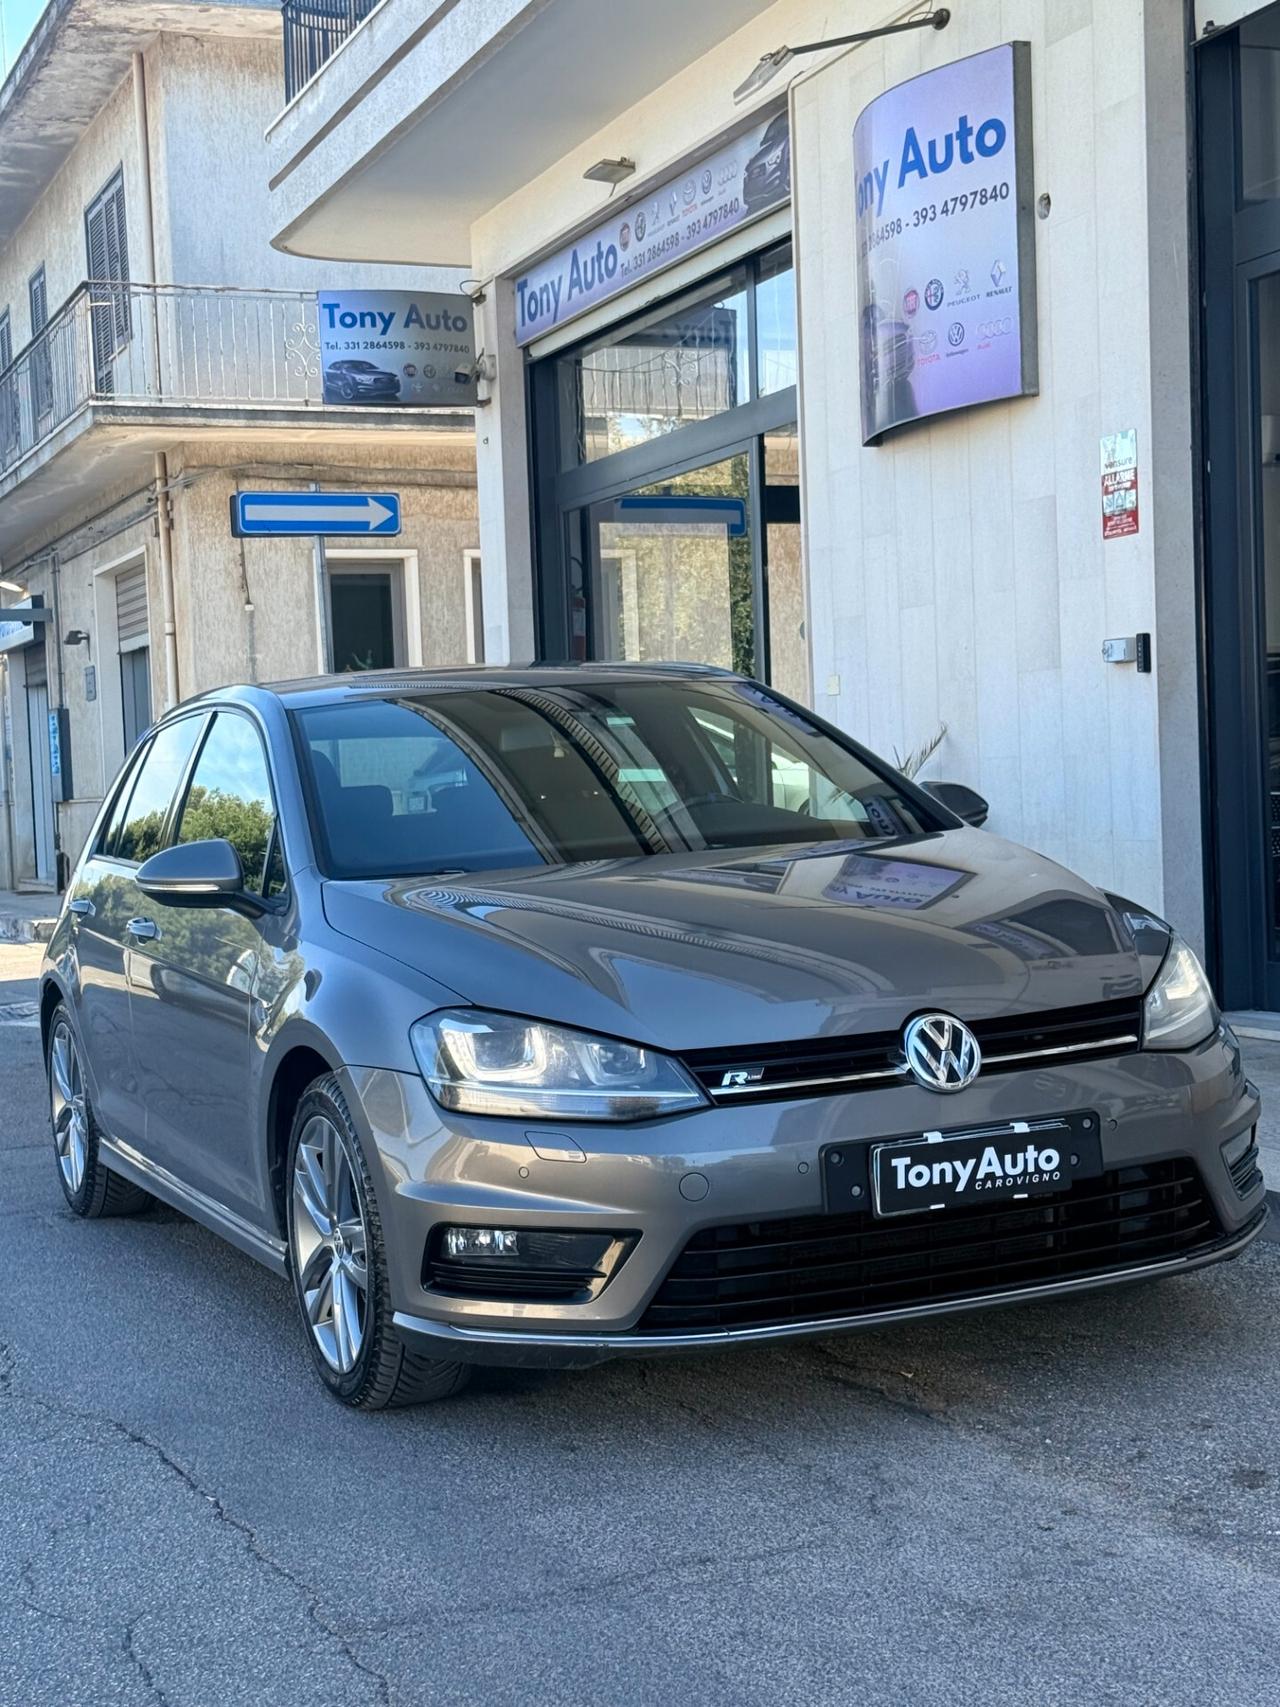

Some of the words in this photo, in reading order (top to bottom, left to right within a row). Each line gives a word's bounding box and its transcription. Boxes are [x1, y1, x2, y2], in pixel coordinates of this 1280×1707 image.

[855, 158, 890, 219] ony
[897, 114, 1007, 190] Auto
[913, 204, 938, 229] 393
[940, 182, 1010, 217] 4797840
[633, 251, 646, 270] 331
[647, 231, 680, 263] 2864598
[686, 219, 701, 241] 393
[702, 197, 740, 230] 4797840
[517, 275, 564, 327] Tony
[567, 241, 618, 302] Auto
[947, 293, 981, 308] PEUGEOT
[322, 303, 396, 336] Tony
[403, 303, 468, 333] Auto
[325, 342, 342, 351] Tel.
[344, 341, 361, 350] 331
[363, 341, 405, 350] 2864598
[414, 342, 431, 352] 393
[432, 343, 470, 354] 4797840
[974, 1171, 1061, 1191] CAROVIGNO
